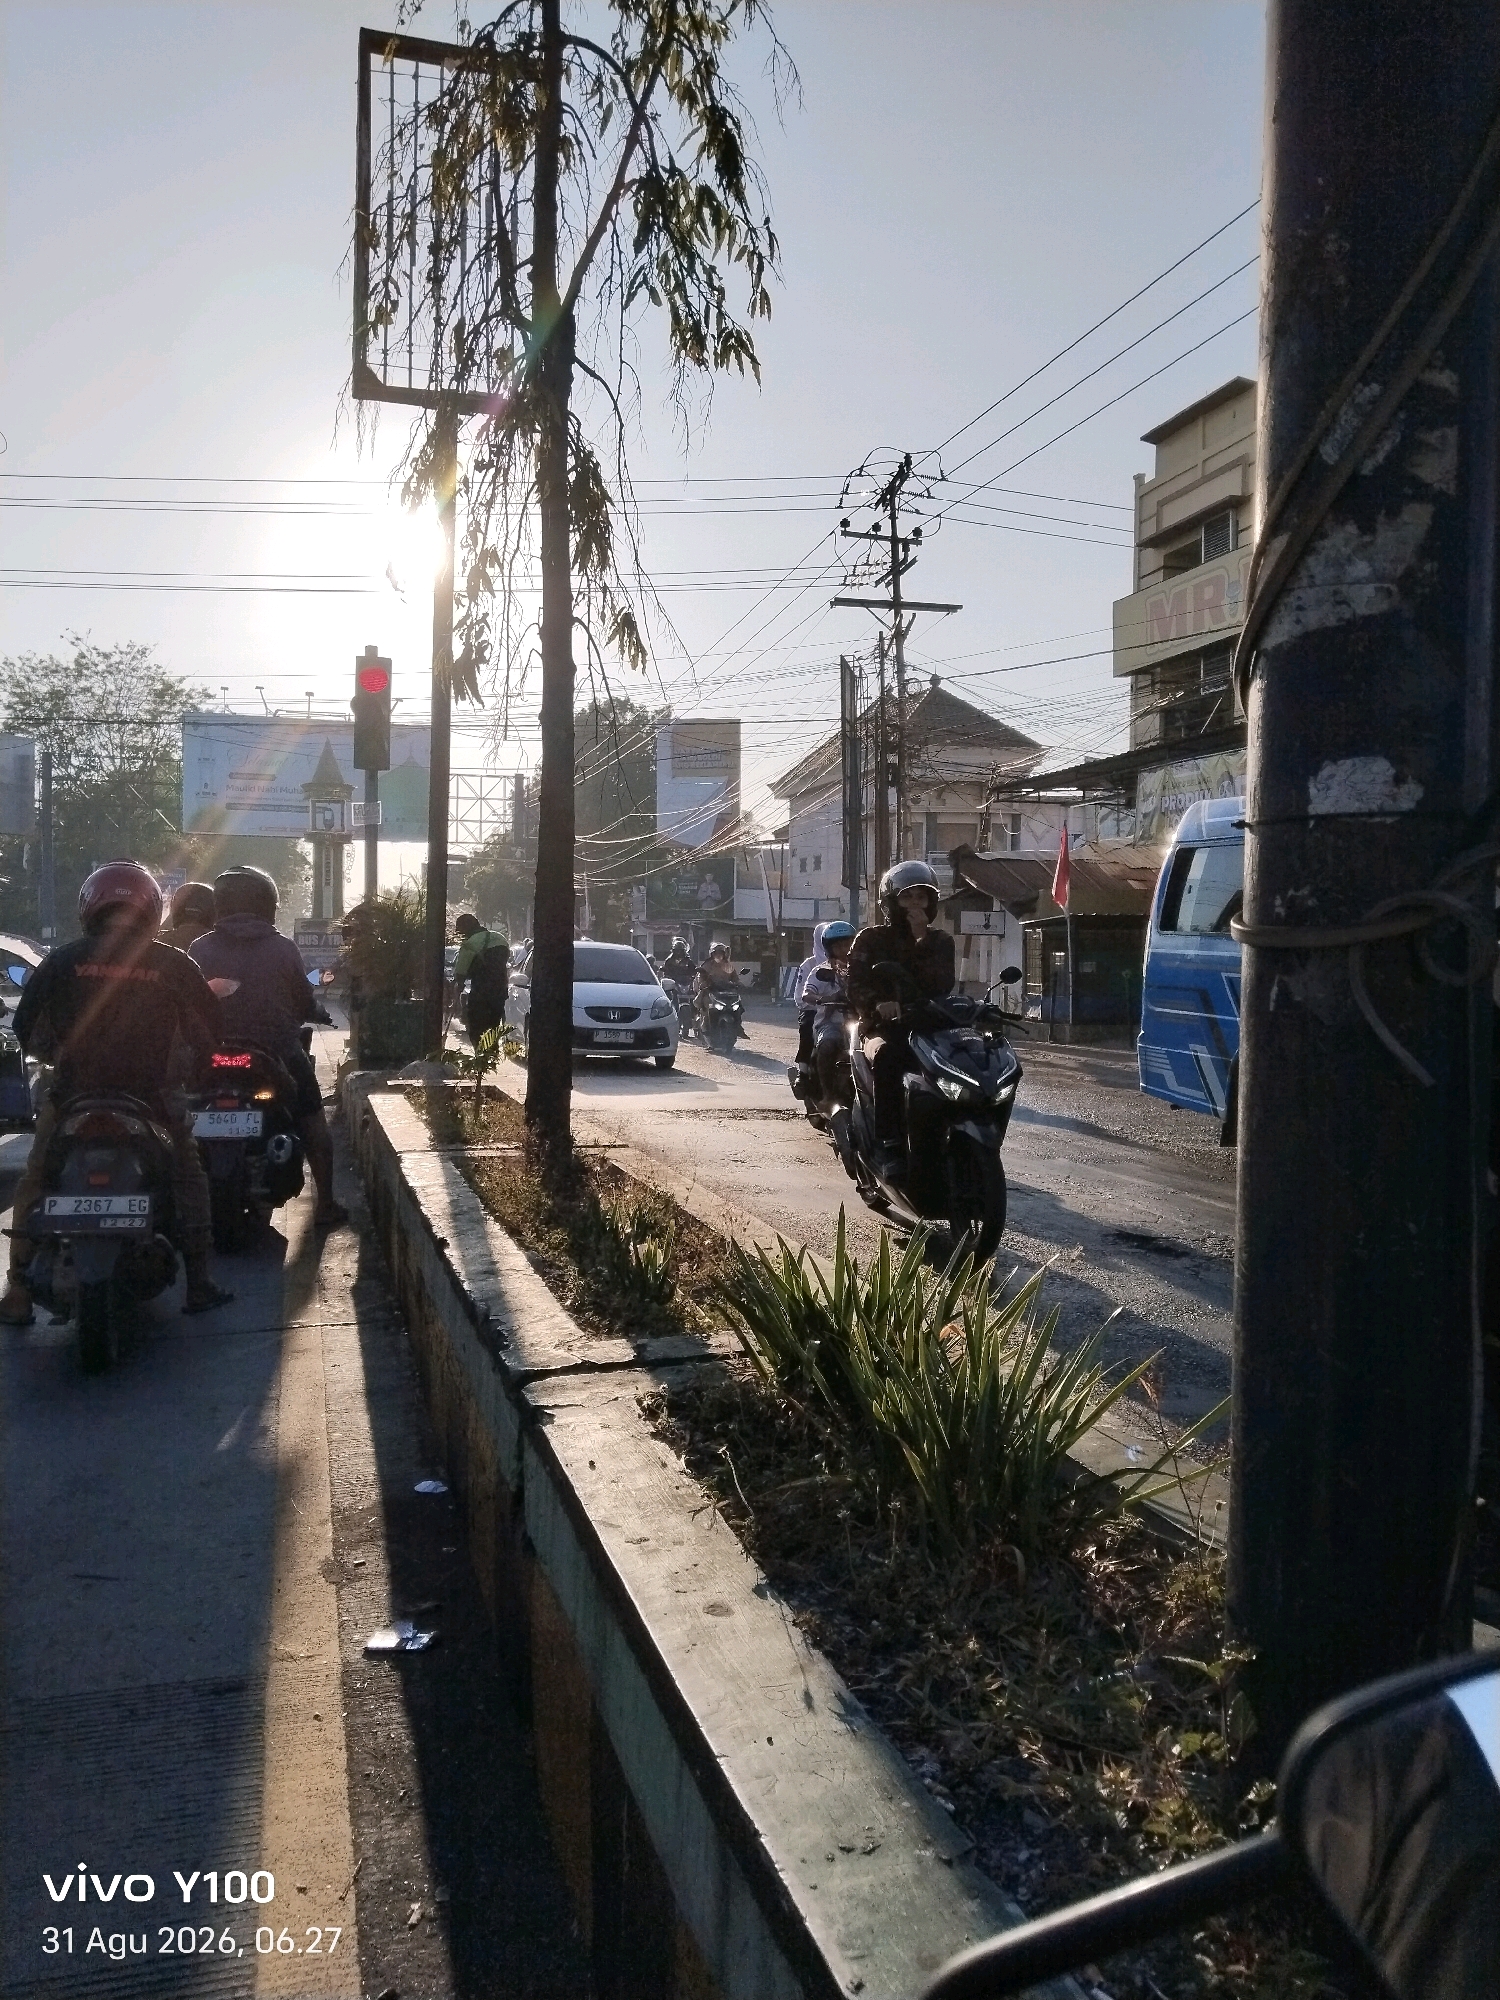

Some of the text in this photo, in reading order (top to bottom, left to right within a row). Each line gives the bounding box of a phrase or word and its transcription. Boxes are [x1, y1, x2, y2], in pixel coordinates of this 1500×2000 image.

[1148, 573, 1228, 645] MR
[225, 784, 256, 793] Maulid
[257, 785, 278, 794] Nabi
[298, 934, 319, 946] BUS
[246, 1113, 260, 1124] FL
[47, 1198, 147, 1214] P 2367 EG
